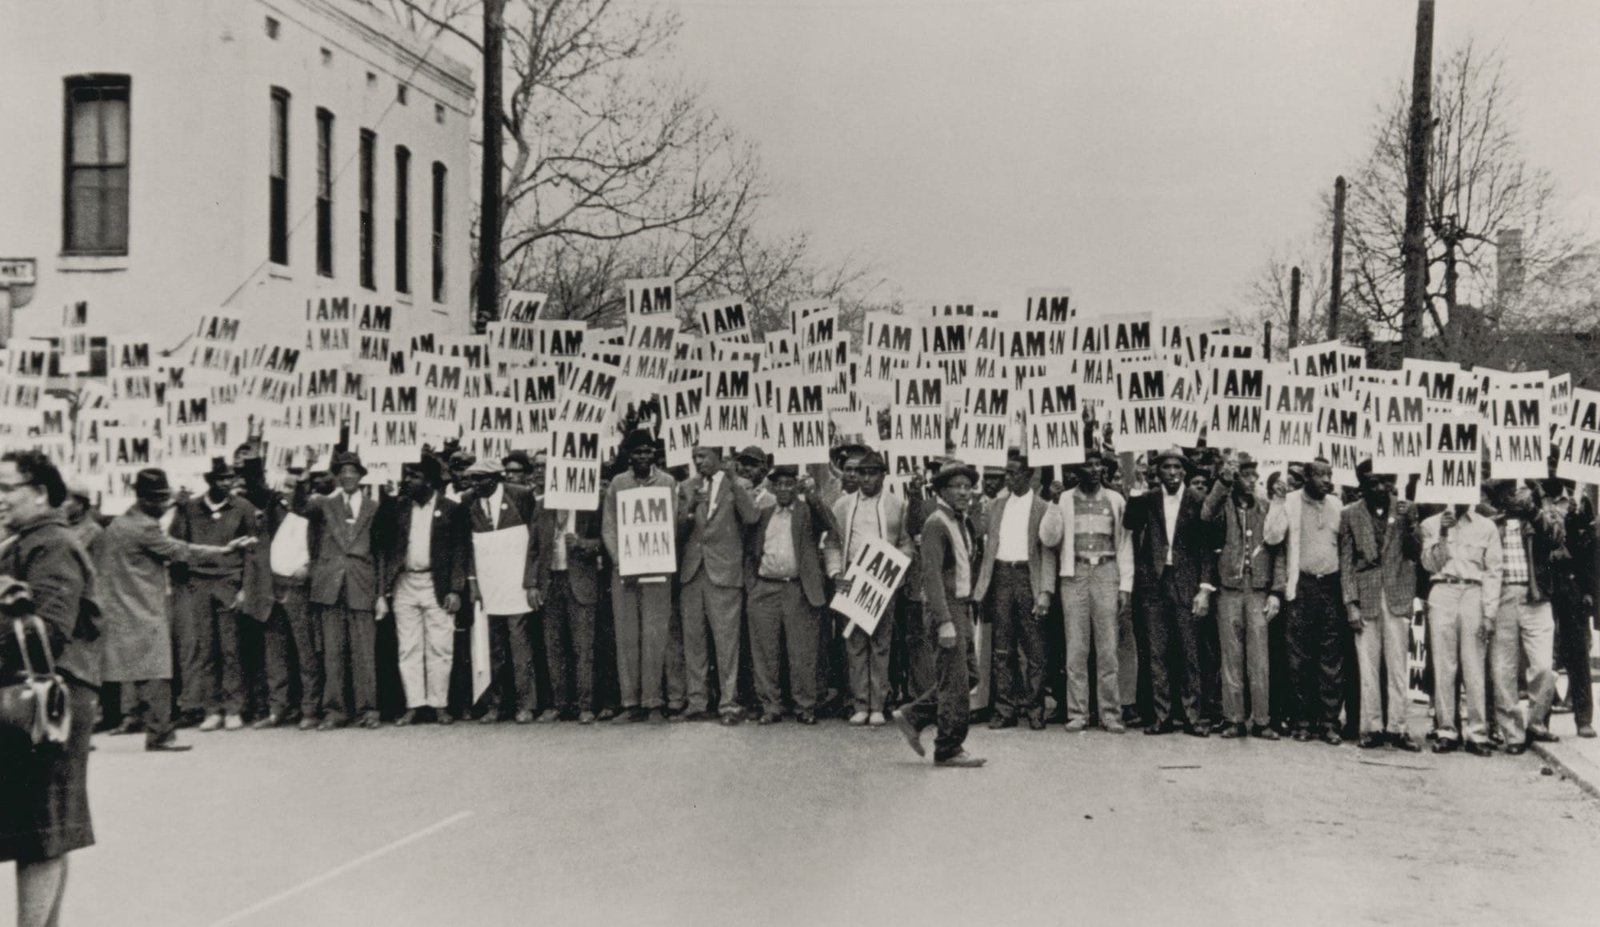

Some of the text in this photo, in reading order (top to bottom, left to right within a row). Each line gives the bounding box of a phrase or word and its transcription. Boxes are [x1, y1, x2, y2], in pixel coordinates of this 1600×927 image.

[306, 297, 349, 320] I AM
[503, 299, 540, 322] I AM
[630, 286, 672, 315] I AM
[1027, 297, 1069, 321] I AM
[197, 316, 240, 341] I AM
[359, 304, 392, 331] AM
[702, 304, 745, 334] I AM
[792, 311, 796, 335] I
[306, 328, 349, 350] A MAN
[499, 327, 534, 351] A MAN
[540, 329, 545, 354] I
[551, 330, 583, 354] AM
[629, 325, 636, 347] I
[638, 326, 674, 350] AM
[808, 317, 833, 345] AM
[867, 322, 912, 350] I AM
[922, 325, 965, 352] I AM
[1000, 331, 1046, 357] I AM
[1073, 327, 1078, 350] I
[1104, 322, 1150, 350] I AM
[1163, 326, 1166, 347] I
[121, 343, 149, 367] AM
[264, 346, 300, 372] AM
[360, 336, 390, 361] MAN
[808, 348, 832, 373] MAN
[1187, 337, 1194, 361] I
[622, 355, 631, 377] A
[635, 356, 668, 379] MAN
[865, 355, 872, 377] A
[1294, 358, 1298, 375] I
[1306, 351, 1337, 376] AM
[307, 369, 337, 396] AM
[425, 364, 460, 390] AM
[514, 375, 555, 402] I AM
[570, 367, 580, 390] I
[579, 370, 616, 400] AM
[706, 371, 711, 397] I
[716, 371, 748, 397] AM
[1117, 371, 1164, 399] I AM
[1213, 368, 1262, 396] I AM
[1419, 372, 1455, 399] AM
[372, 387, 376, 412] I
[382, 386, 417, 412] AM
[755, 382, 762, 407] I
[776, 385, 822, 413] I AM
[896, 379, 941, 405] I AM
[975, 388, 1008, 415] AM
[1029, 385, 1076, 414] I AM
[1266, 385, 1314, 412] I AM
[177, 398, 207, 424] AM
[426, 395, 457, 421] MAN
[471, 407, 512, 431] I AM
[560, 400, 606, 423] A MAN
[664, 395, 670, 419] I
[704, 405, 748, 431] A MAN
[1171, 407, 1197, 432] MAN
[1212, 405, 1261, 432] A MAN
[1375, 397, 1380, 422] I
[1387, 397, 1423, 422] AM
[1493, 400, 1540, 426] I AM
[1570, 400, 1580, 426] I
[372, 421, 417, 446] A MAN
[516, 411, 523, 434] A
[762, 415, 770, 439] A
[896, 414, 903, 439] A
[911, 414, 941, 439] MAN
[1120, 407, 1166, 434] A MAN
[1263, 420, 1311, 446] A MAN
[1317, 407, 1324, 432] I
[1327, 409, 1357, 437] AM
[552, 431, 598, 459] I AM
[669, 427, 676, 451] A
[778, 420, 824, 448] A MAN
[962, 423, 1005, 449] A MAN
[1033, 420, 1079, 449] A MAN
[1377, 432, 1422, 456] A MAN
[1426, 423, 1478, 450] I AM
[106, 438, 110, 463] I
[117, 438, 149, 463] AM
[483, 438, 512, 459] MAN
[1331, 444, 1357, 469] MAN
[1495, 435, 1542, 461] A MAN
[1564, 436, 1574, 462] A
[550, 467, 596, 493] A MAN
[1425, 459, 1476, 486] A MAN
[622, 498, 667, 525] I AM
[624, 532, 670, 557] A MAN
[857, 543, 901, 588] I AM
[855, 581, 886, 618] MAN
